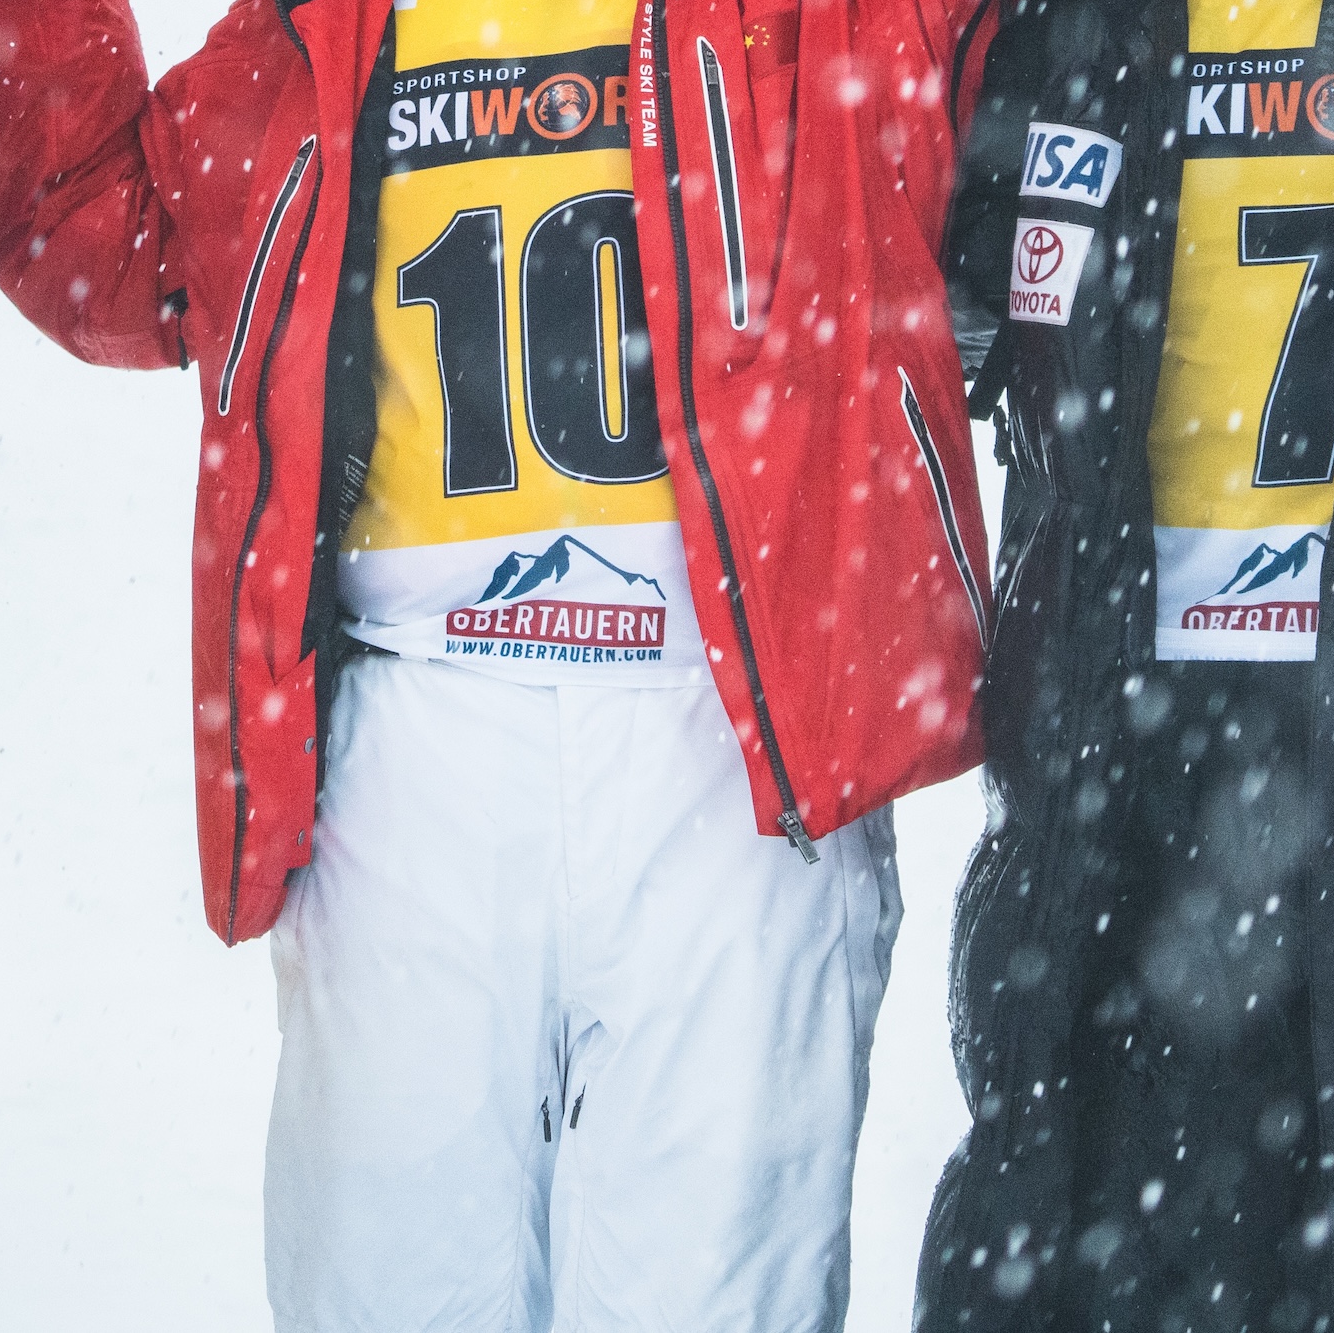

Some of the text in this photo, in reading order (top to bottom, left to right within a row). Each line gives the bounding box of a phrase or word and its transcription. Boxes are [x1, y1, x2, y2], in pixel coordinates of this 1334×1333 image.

[639, 3, 654, 59] STYLE
[392, 66, 527, 95] SPORTSHOP
[639, 64, 654, 92] SKI
[640, 98, 658, 147] TEAM
[397, 189, 670, 498] 10
[452, 604, 659, 642] OBERTAUERN
[445, 640, 662, 663] WWW.OBERTAUERN.COM
